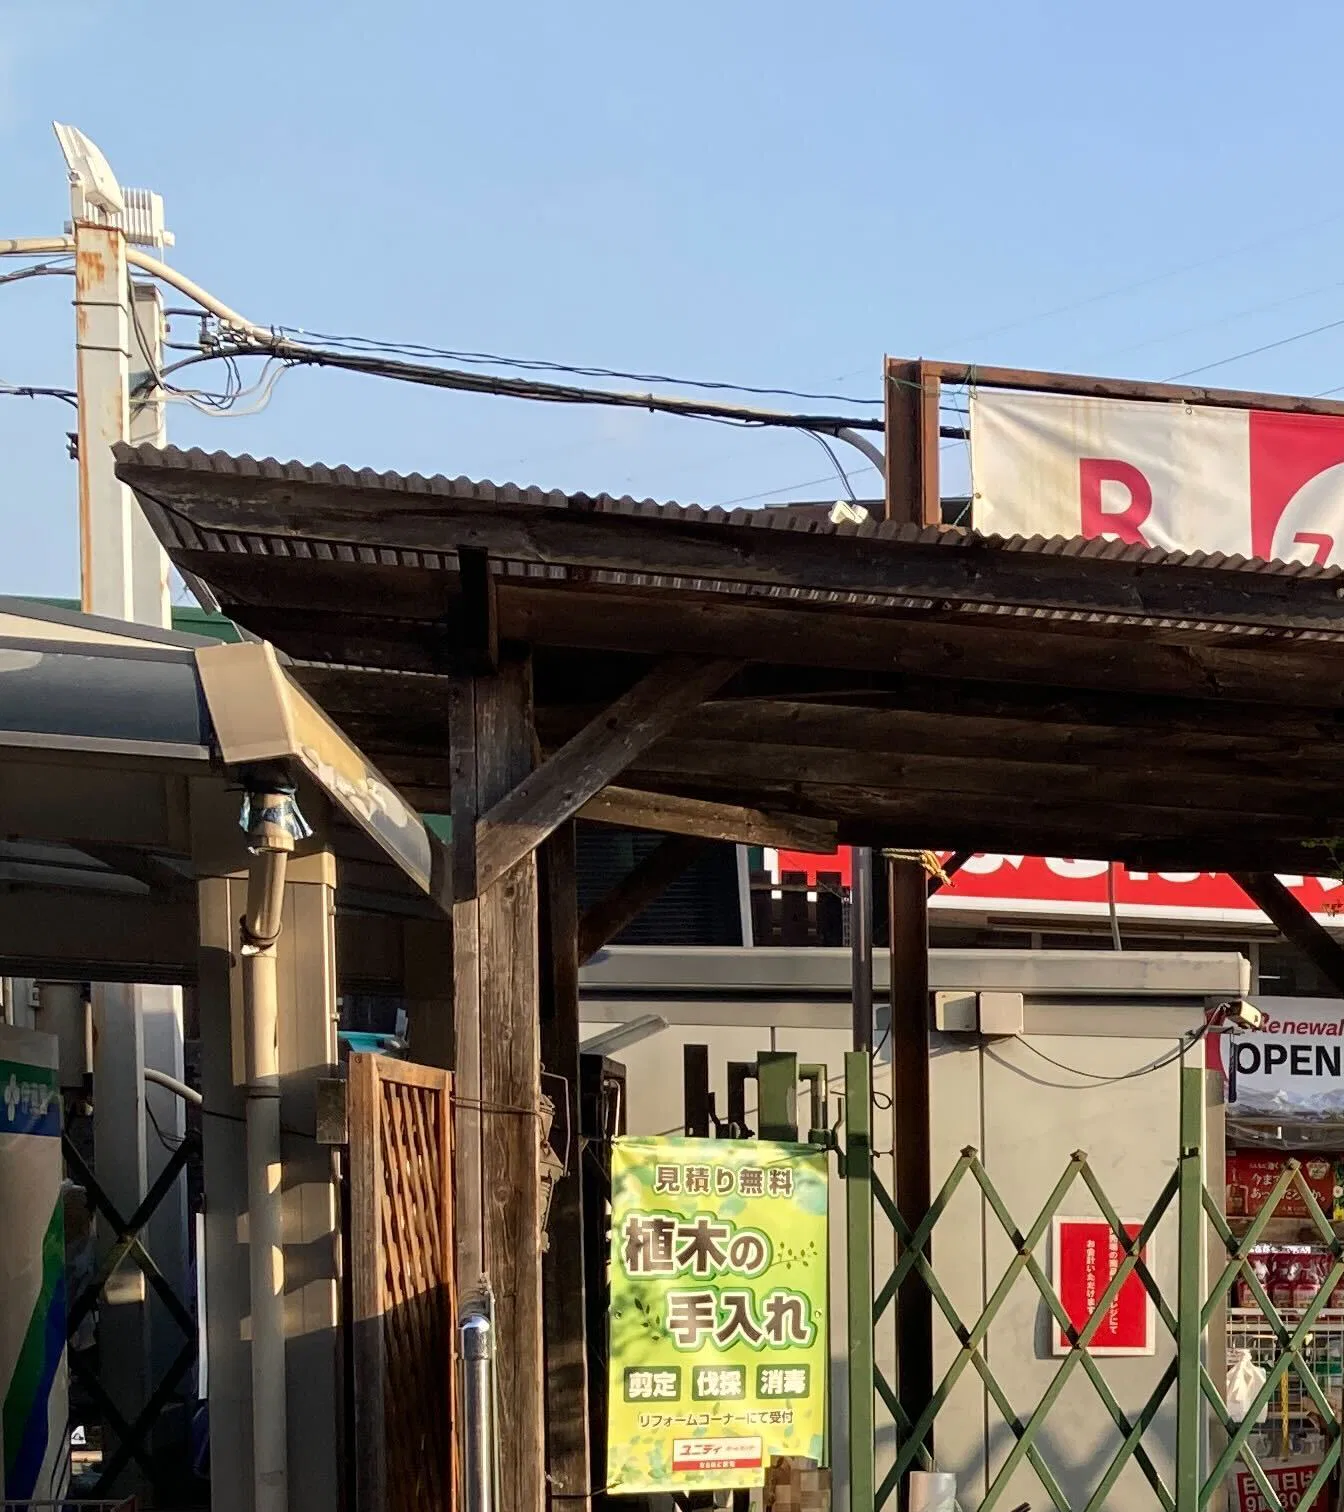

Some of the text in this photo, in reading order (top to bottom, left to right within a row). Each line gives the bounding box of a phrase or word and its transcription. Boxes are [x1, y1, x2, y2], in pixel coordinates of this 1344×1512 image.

[1079, 457, 1153, 548] R
[654, 1165, 794, 1196] 見積り無料
[623, 1216, 766, 1275] 植木の
[668, 1293, 809, 1345] 手入れ
[629, 1369, 806, 1398] 剪定 伐採 消毒
[640, 1411, 794, 1428] リフォームコーナーにて受付
[679, 1444, 723, 1456] ユニディ
